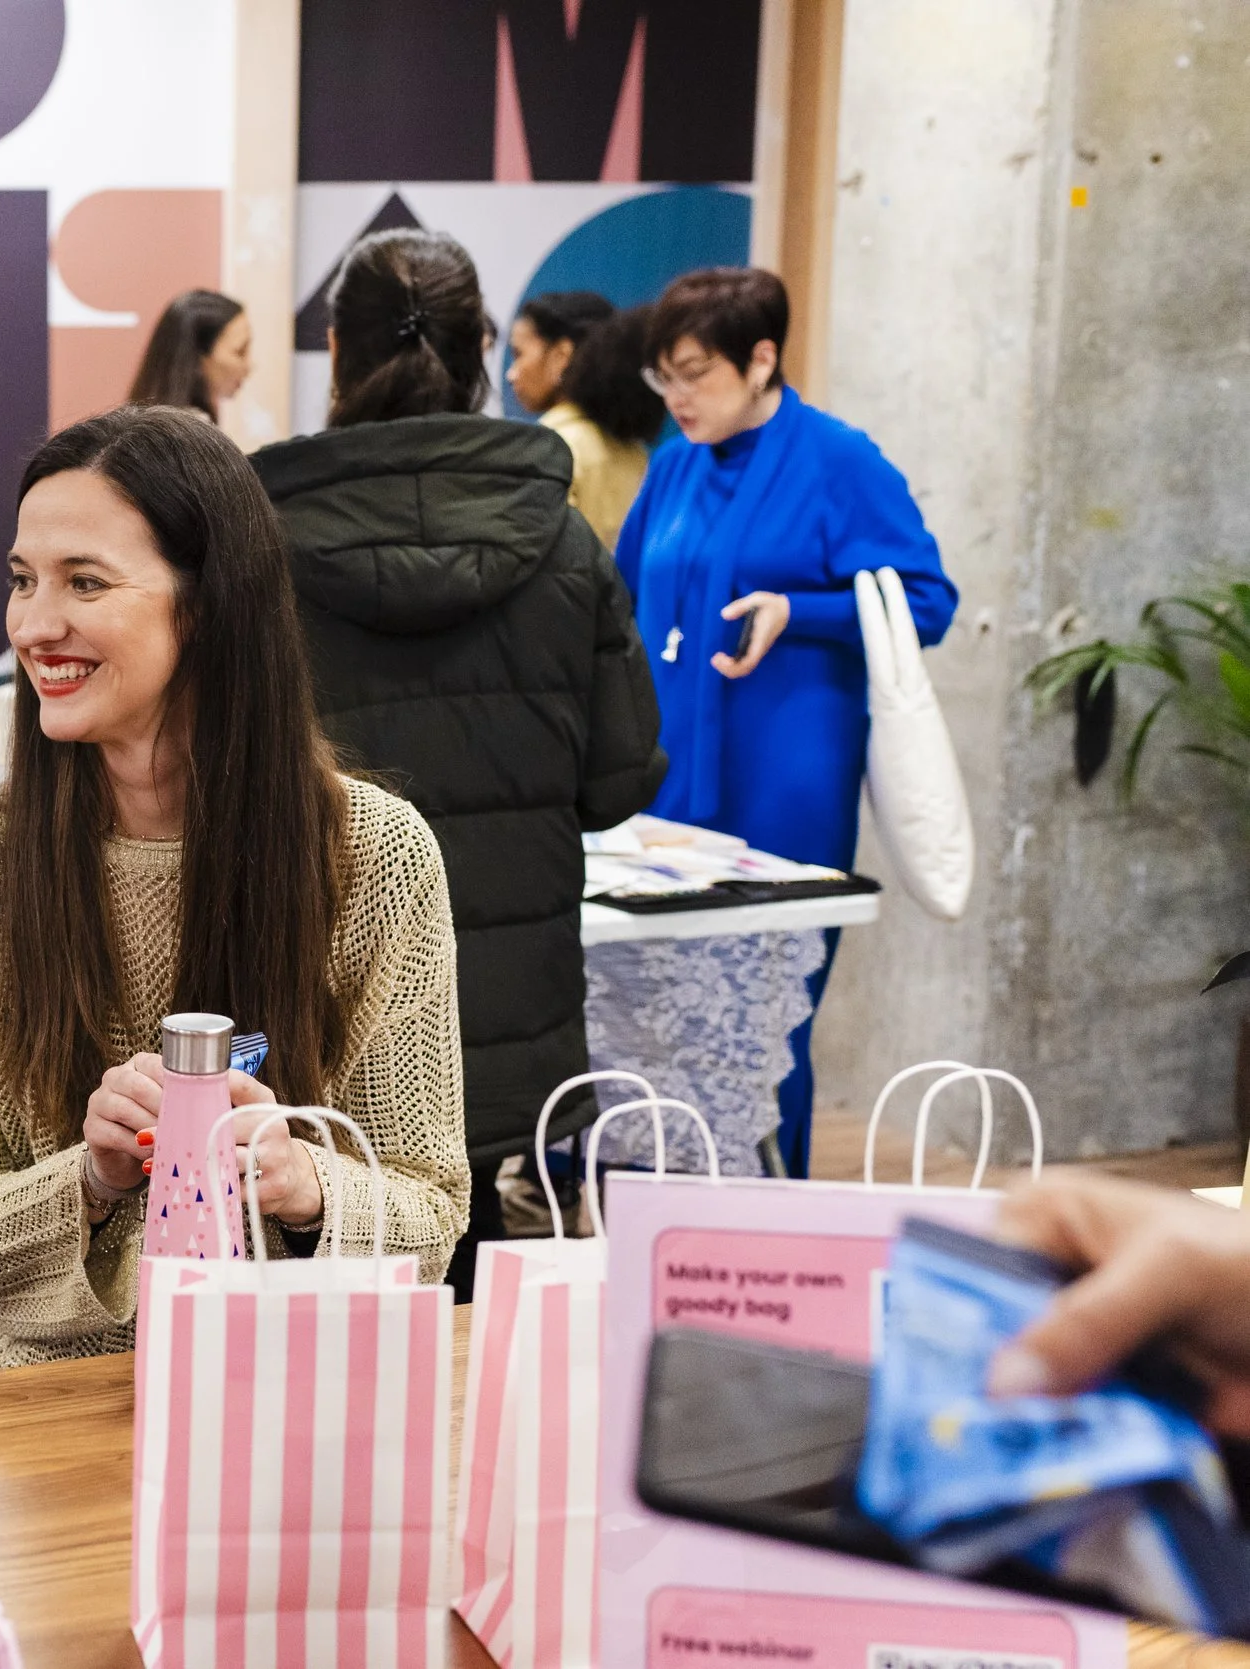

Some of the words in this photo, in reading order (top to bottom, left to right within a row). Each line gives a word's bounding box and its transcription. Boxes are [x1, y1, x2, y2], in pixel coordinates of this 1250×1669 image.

[666, 1262, 729, 1283] Make
[735, 1271, 789, 1290] your
[793, 1272, 845, 1289] own
[665, 1296, 737, 1320] goody
[744, 1298, 792, 1323] bag
[660, 1632, 711, 1655] Free
[716, 1637, 816, 1661] webinar
